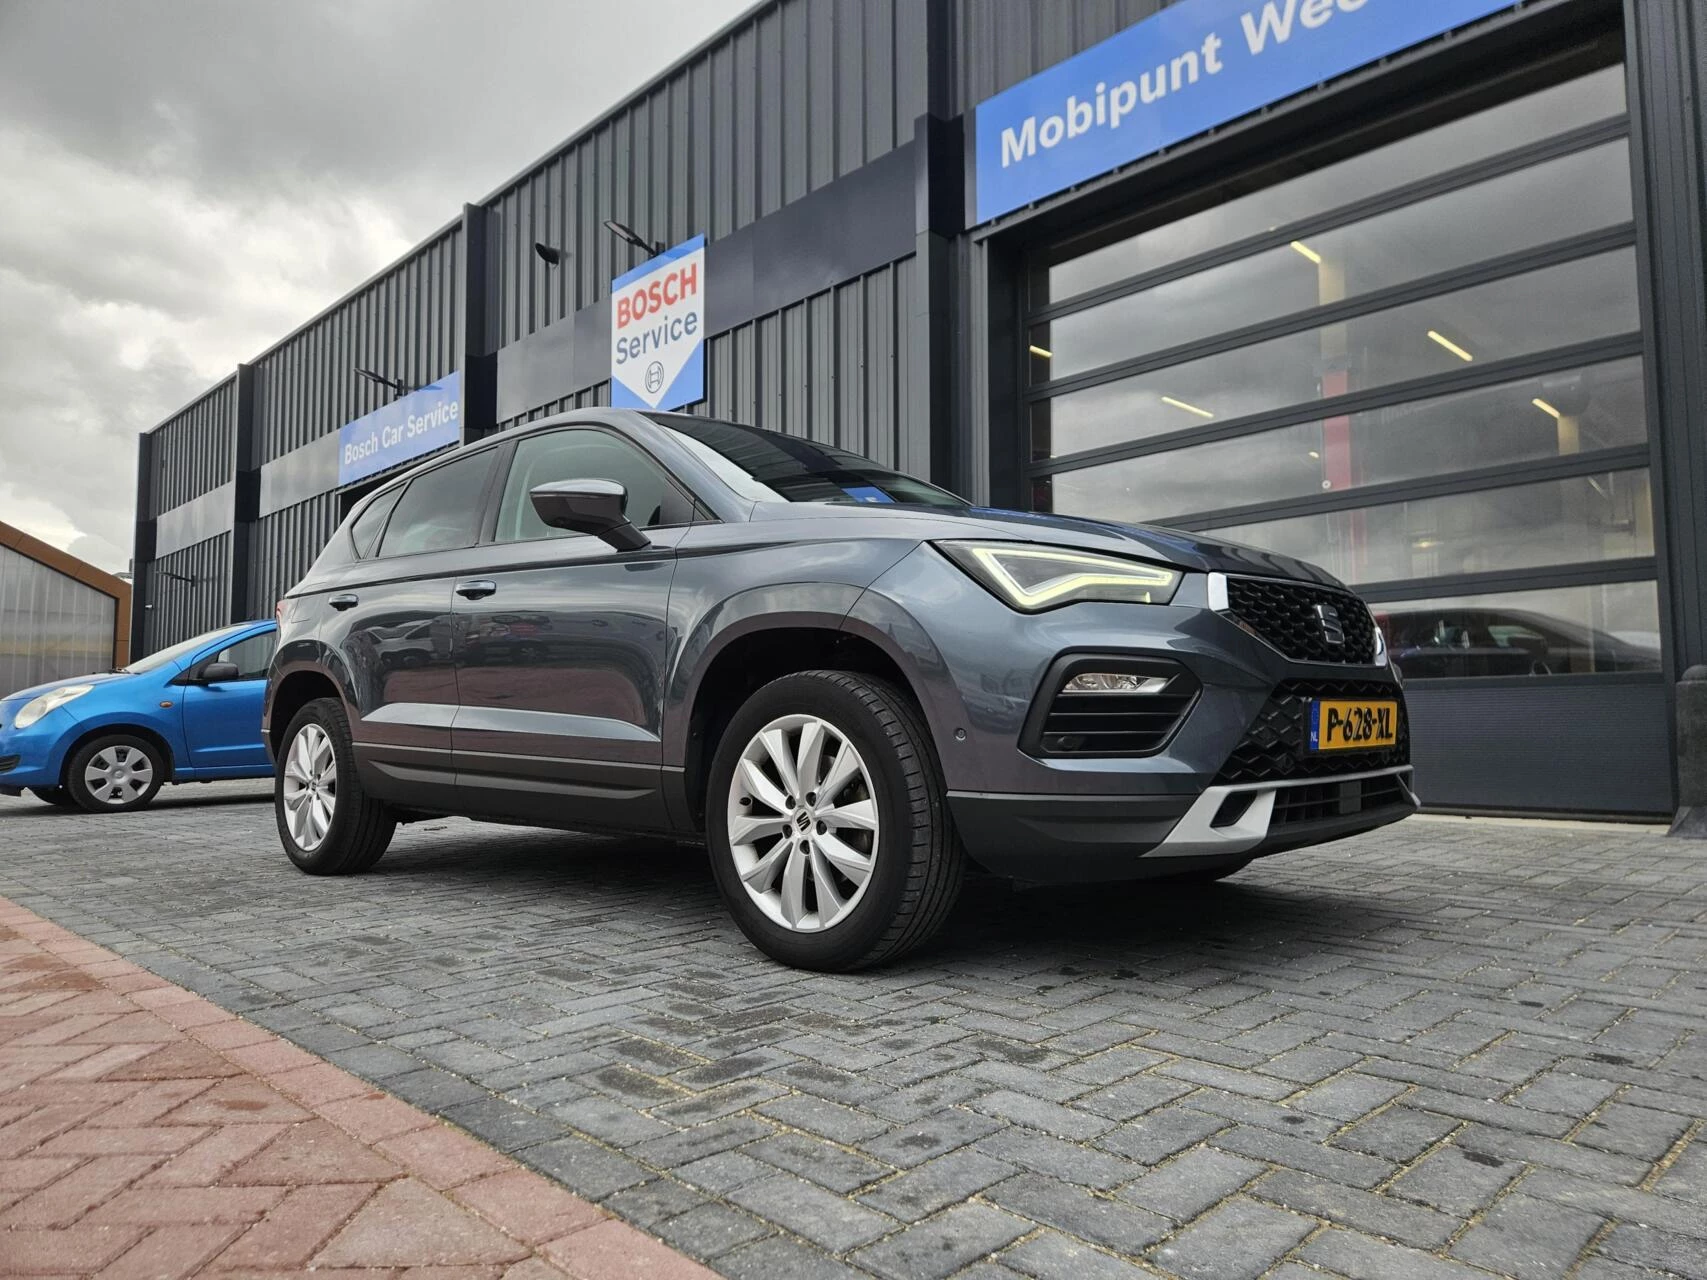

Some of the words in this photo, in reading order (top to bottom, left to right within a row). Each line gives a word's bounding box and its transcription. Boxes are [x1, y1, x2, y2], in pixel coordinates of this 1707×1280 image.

[1001, 32, 1223, 168] Mobipunt
[617, 263, 697, 329] BOSCH
[616, 311, 698, 365] Service
[344, 432, 379, 465] Bosch
[382, 424, 404, 449] Car
[407, 401, 459, 438] Service
[1310, 731, 1319, 742] NL
[1327, 707, 1393, 742] P-628-XL
